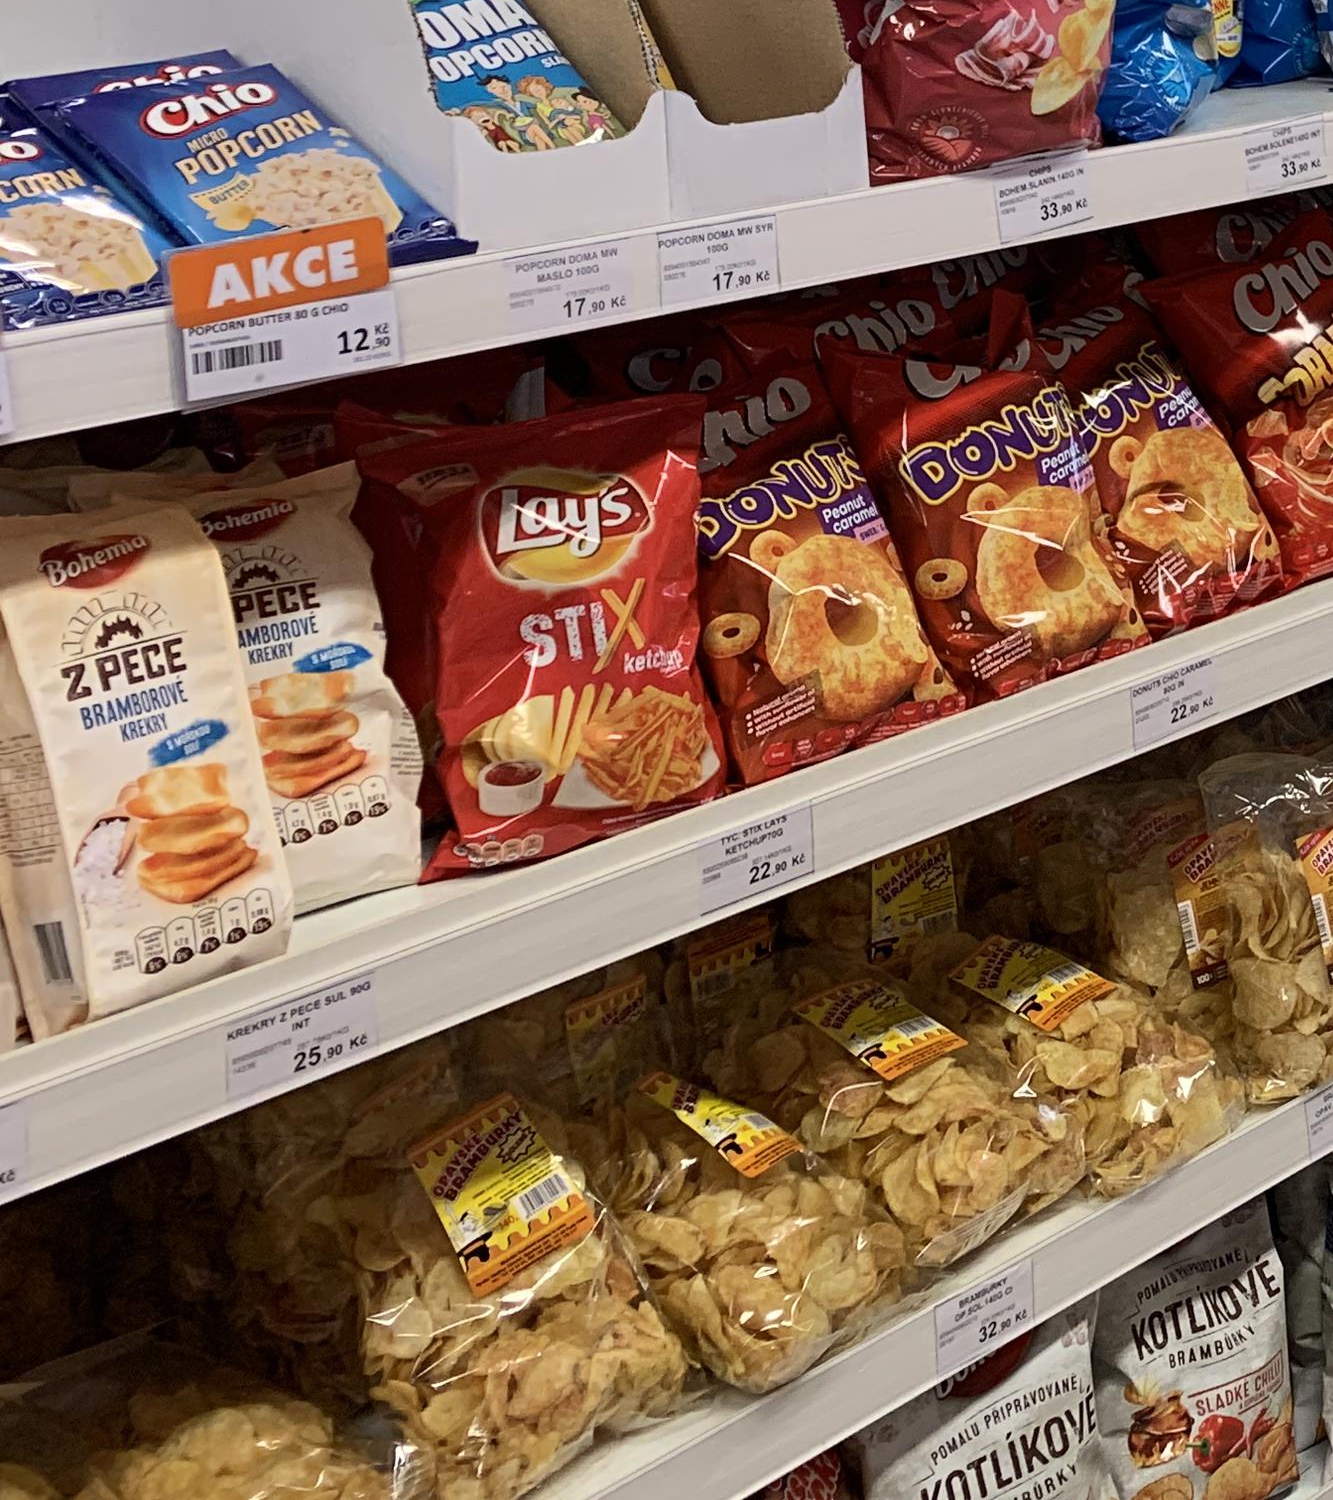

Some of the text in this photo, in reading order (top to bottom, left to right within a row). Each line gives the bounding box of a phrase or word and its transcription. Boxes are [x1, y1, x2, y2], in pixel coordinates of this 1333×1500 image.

[431, 30, 557, 83] OPCORN
[141, 80, 276, 136] Chio
[175, 110, 323, 185] POPCORN
[187, 127, 229, 152] MICRO
[208, 177, 250, 205] BUTTER
[658, 222, 774, 251] POPCORN DOMA MW SYR
[706, 242, 730, 256] 100G
[206, 239, 360, 310] AKCE
[515, 256, 566, 275] POPCORN
[568, 250, 600, 266] DOMA
[537, 263, 601, 285] MASLO 100G
[755, 269, 771, 283] Kč
[611, 295, 627, 310] Kč
[188, 321, 245, 337] POPCORN
[247, 315, 292, 331] BUTTER
[308, 309, 318, 319] G
[321, 303, 349, 317] CHIO
[374, 321, 390, 336] Kč
[496, 484, 634, 558] Lay's
[822, 494, 867, 524] Peanut
[832, 506, 880, 535] caramel
[39, 534, 150, 590] Bohemia
[235, 579, 321, 623] PECE
[237, 615, 320, 650] AMBOROVÉ
[519, 578, 647, 675] STIX
[248, 640, 295, 665] KREKRY
[623, 646, 685, 678] ketchup
[62, 636, 188, 702] Z PECE
[79, 676, 190, 731] BRAMBOROVÉ
[120, 711, 169, 743] KREKRY
[791, 854, 806, 870] Kč
[227, 979, 372, 1042] KREKRY Z PECE SUL 90G
[349, 1032, 369, 1051] Kč
[1195, 1382, 1246, 1416] SLADKÉ
